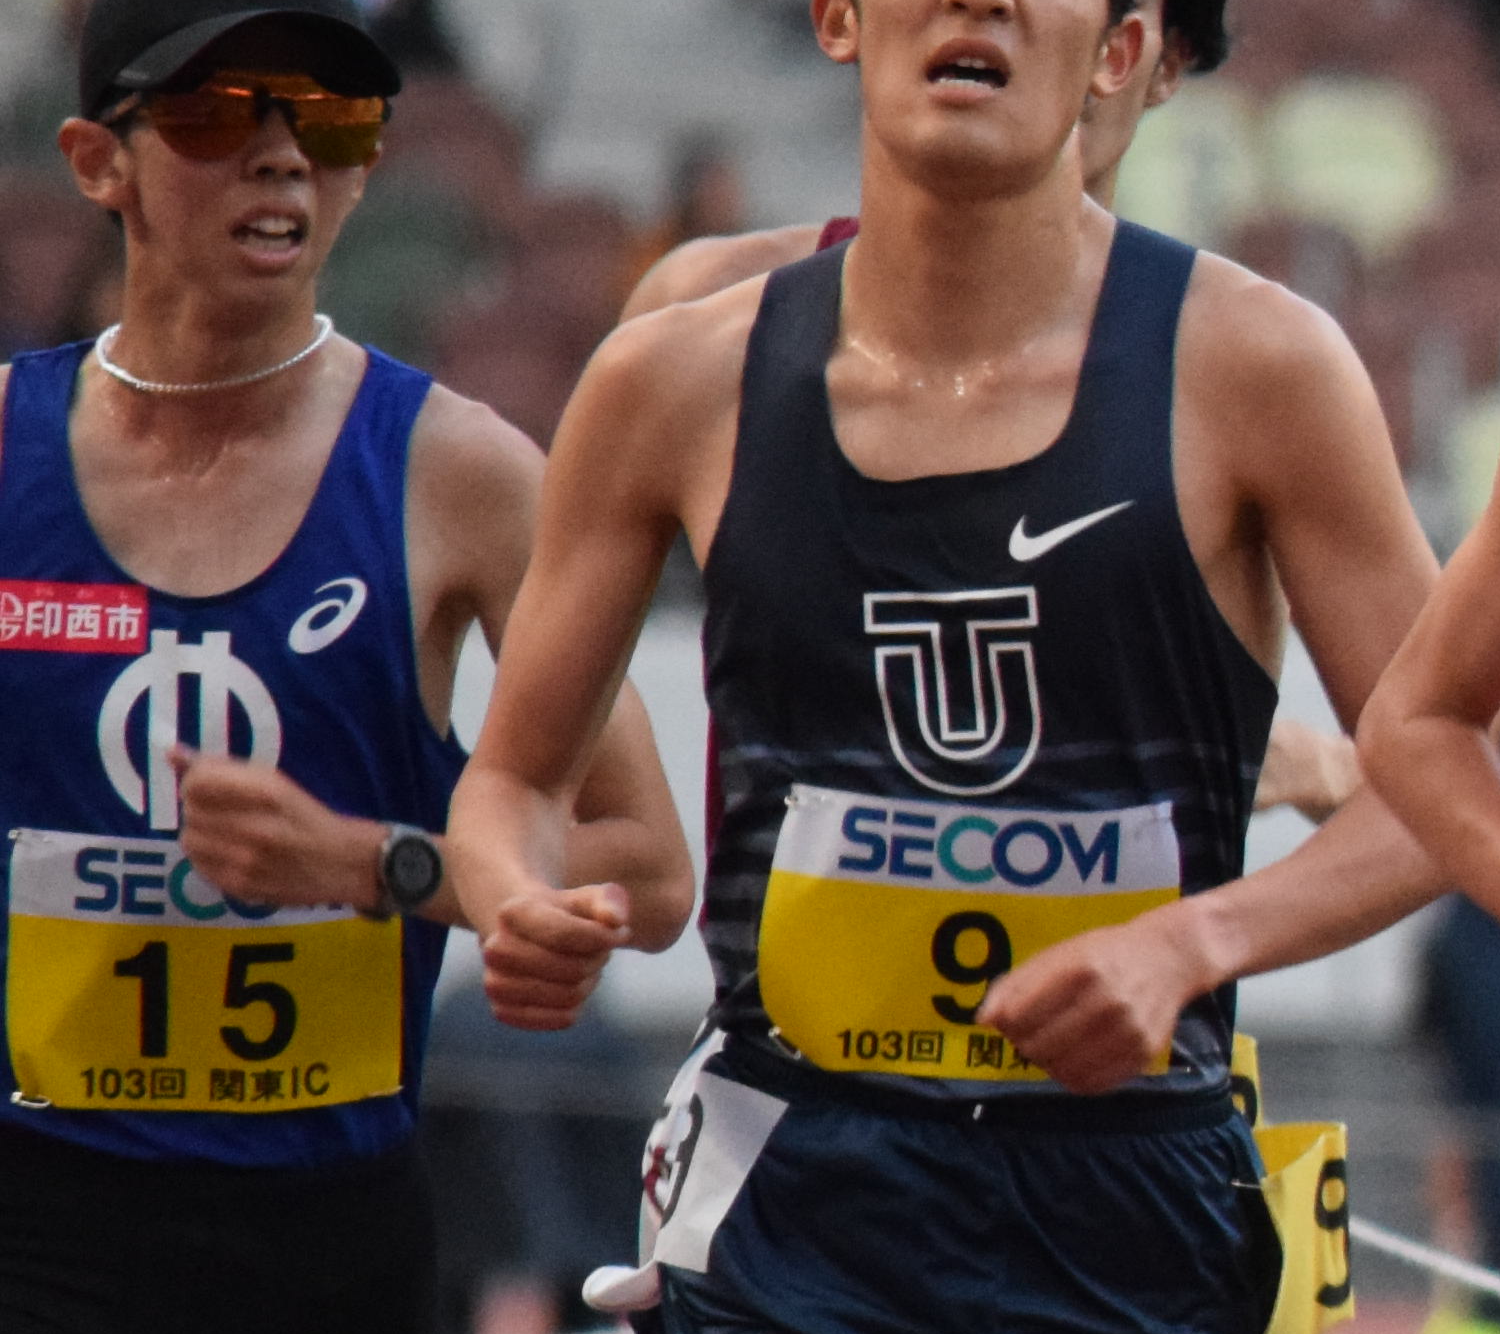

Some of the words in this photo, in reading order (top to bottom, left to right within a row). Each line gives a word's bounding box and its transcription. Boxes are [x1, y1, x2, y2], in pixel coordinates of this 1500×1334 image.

[25, 599, 143, 641] 印西市
[838, 807, 1120, 887] SECOM
[931, 910, 1013, 1025] 9
[113, 940, 298, 1062] 15
[836, 1028, 945, 1065] 103回
[80, 1065, 188, 1102] 103回
[208, 1063, 331, 1103] 関東IC
